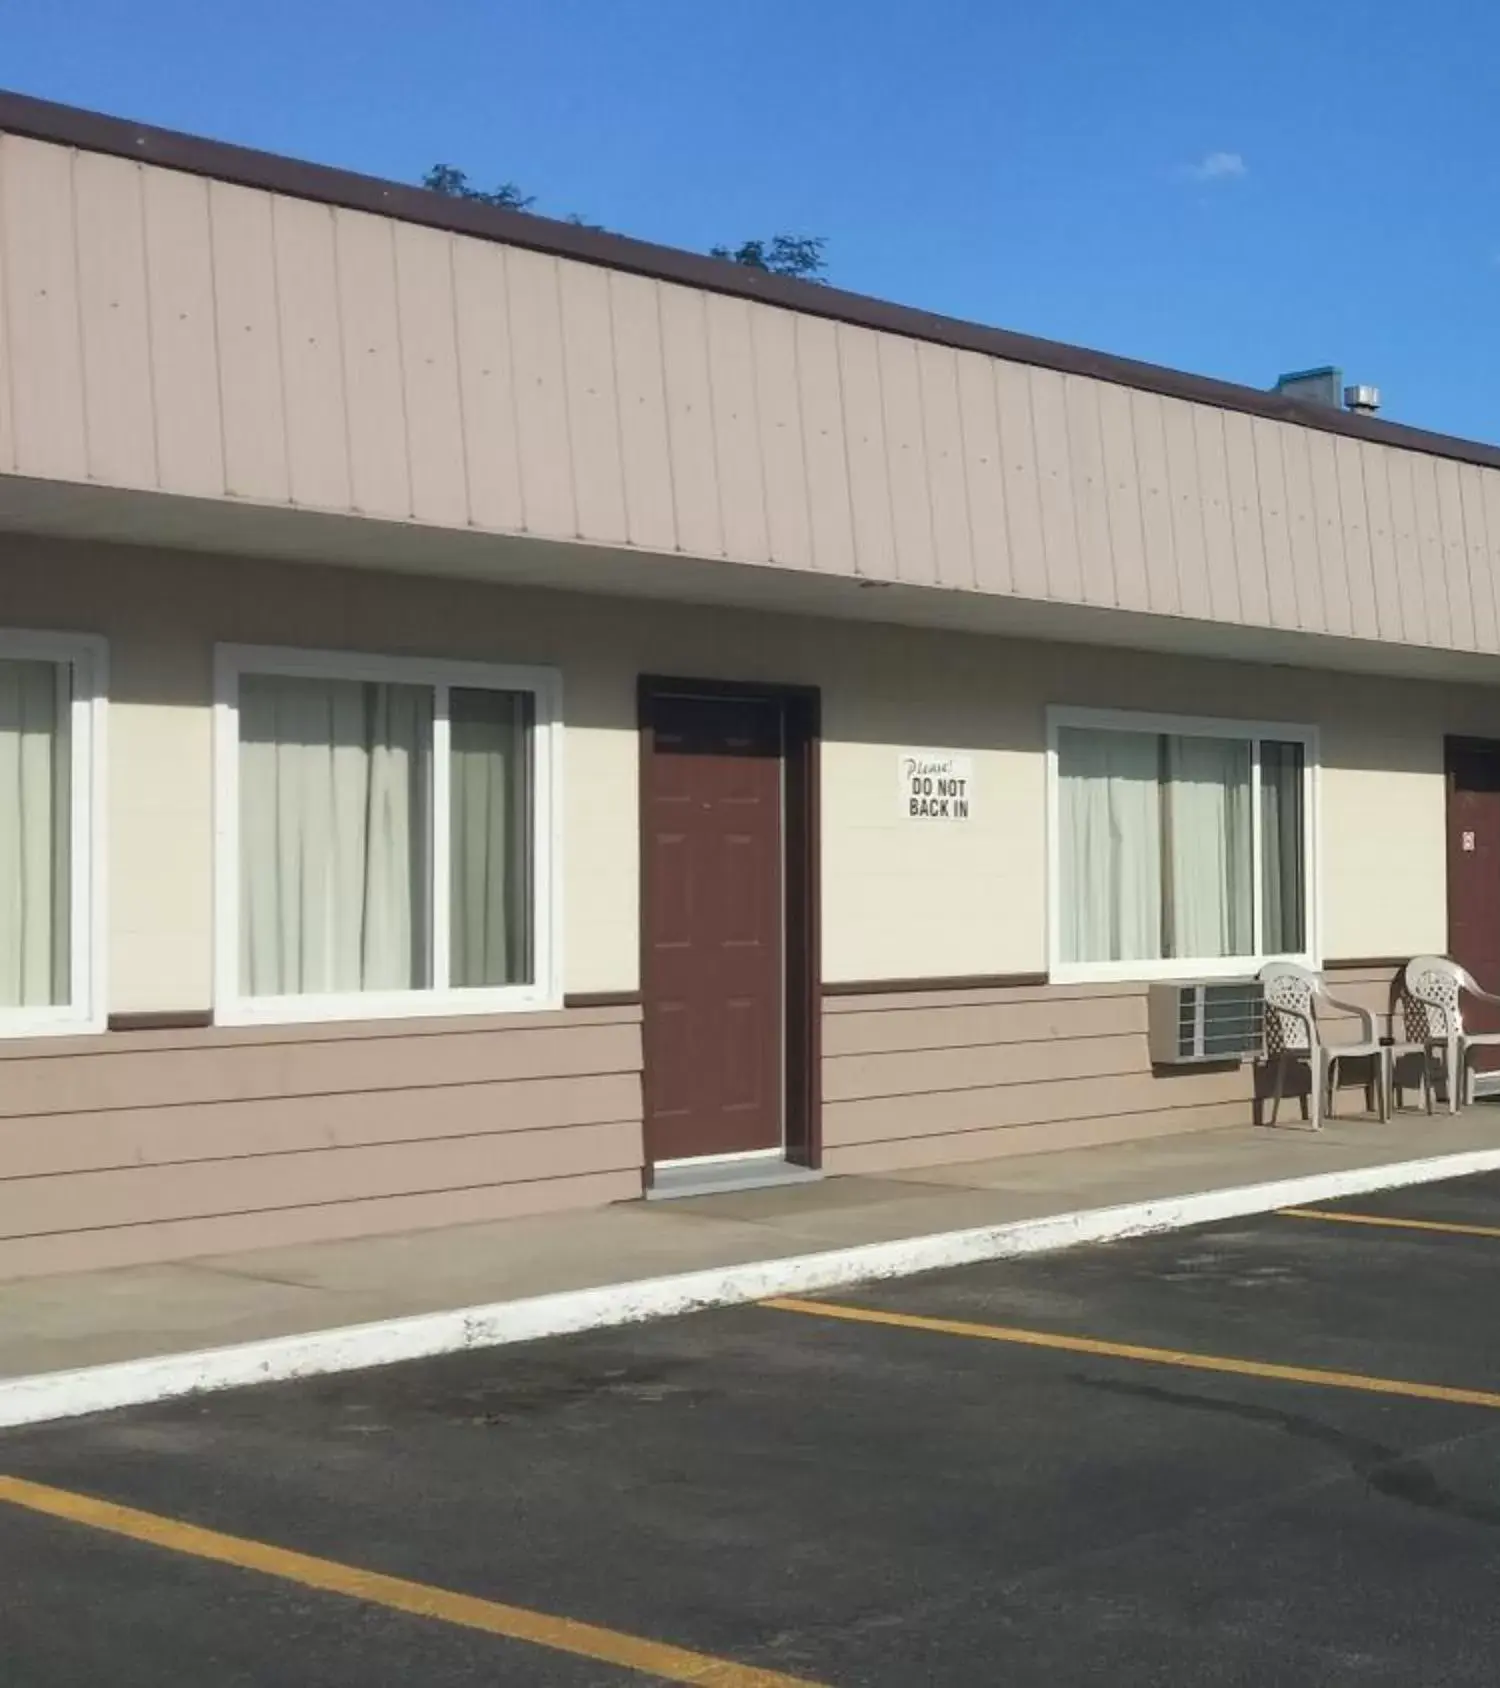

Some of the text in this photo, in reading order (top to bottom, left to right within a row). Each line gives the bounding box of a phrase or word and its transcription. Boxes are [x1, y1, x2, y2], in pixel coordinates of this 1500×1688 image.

[912, 777, 967, 797] DO NOT
[909, 797, 969, 817] BACK IN
